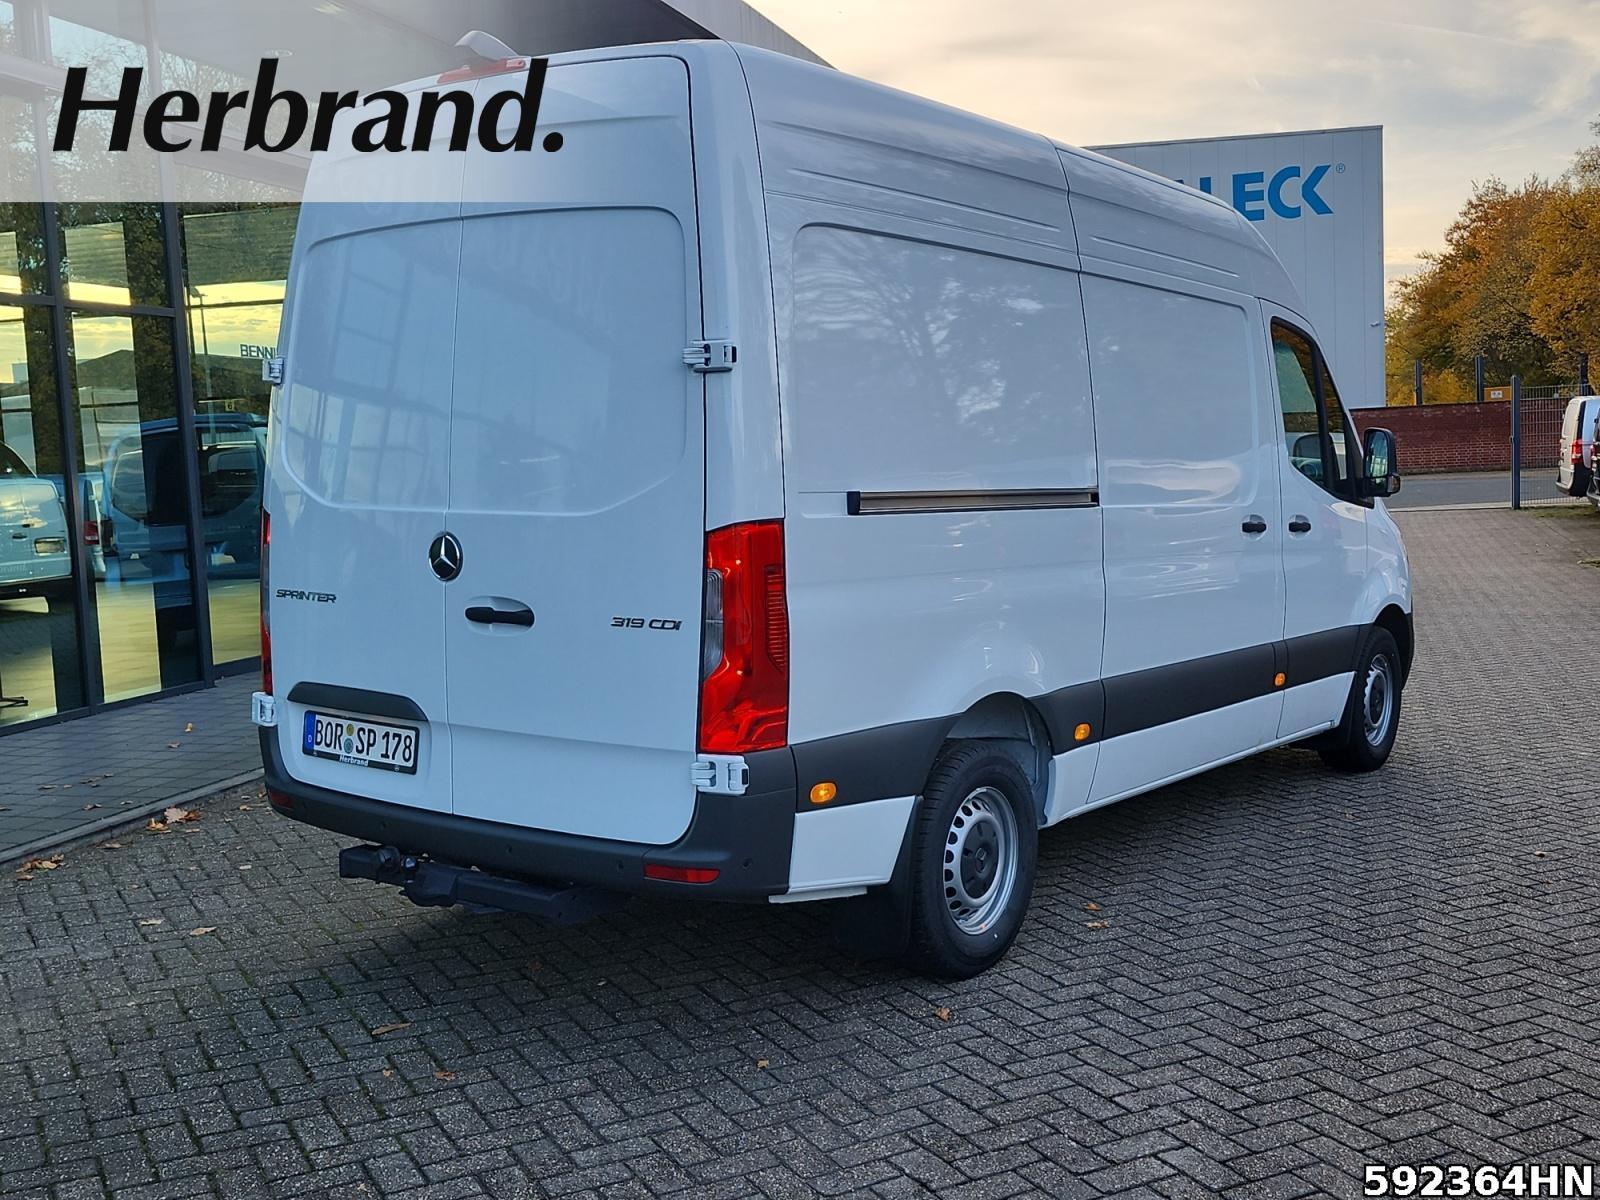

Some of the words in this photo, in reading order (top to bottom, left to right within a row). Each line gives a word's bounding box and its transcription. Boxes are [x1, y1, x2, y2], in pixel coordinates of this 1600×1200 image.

[275, 589, 337, 604] SPRINTER
[610, 617, 645, 629] 319
[648, 619, 682, 631] CDI
[314, 719, 344, 751] BOR
[355, 726, 377, 756] SP
[380, 731, 413, 763] 178
[339, 754, 369, 767] Herbrand
